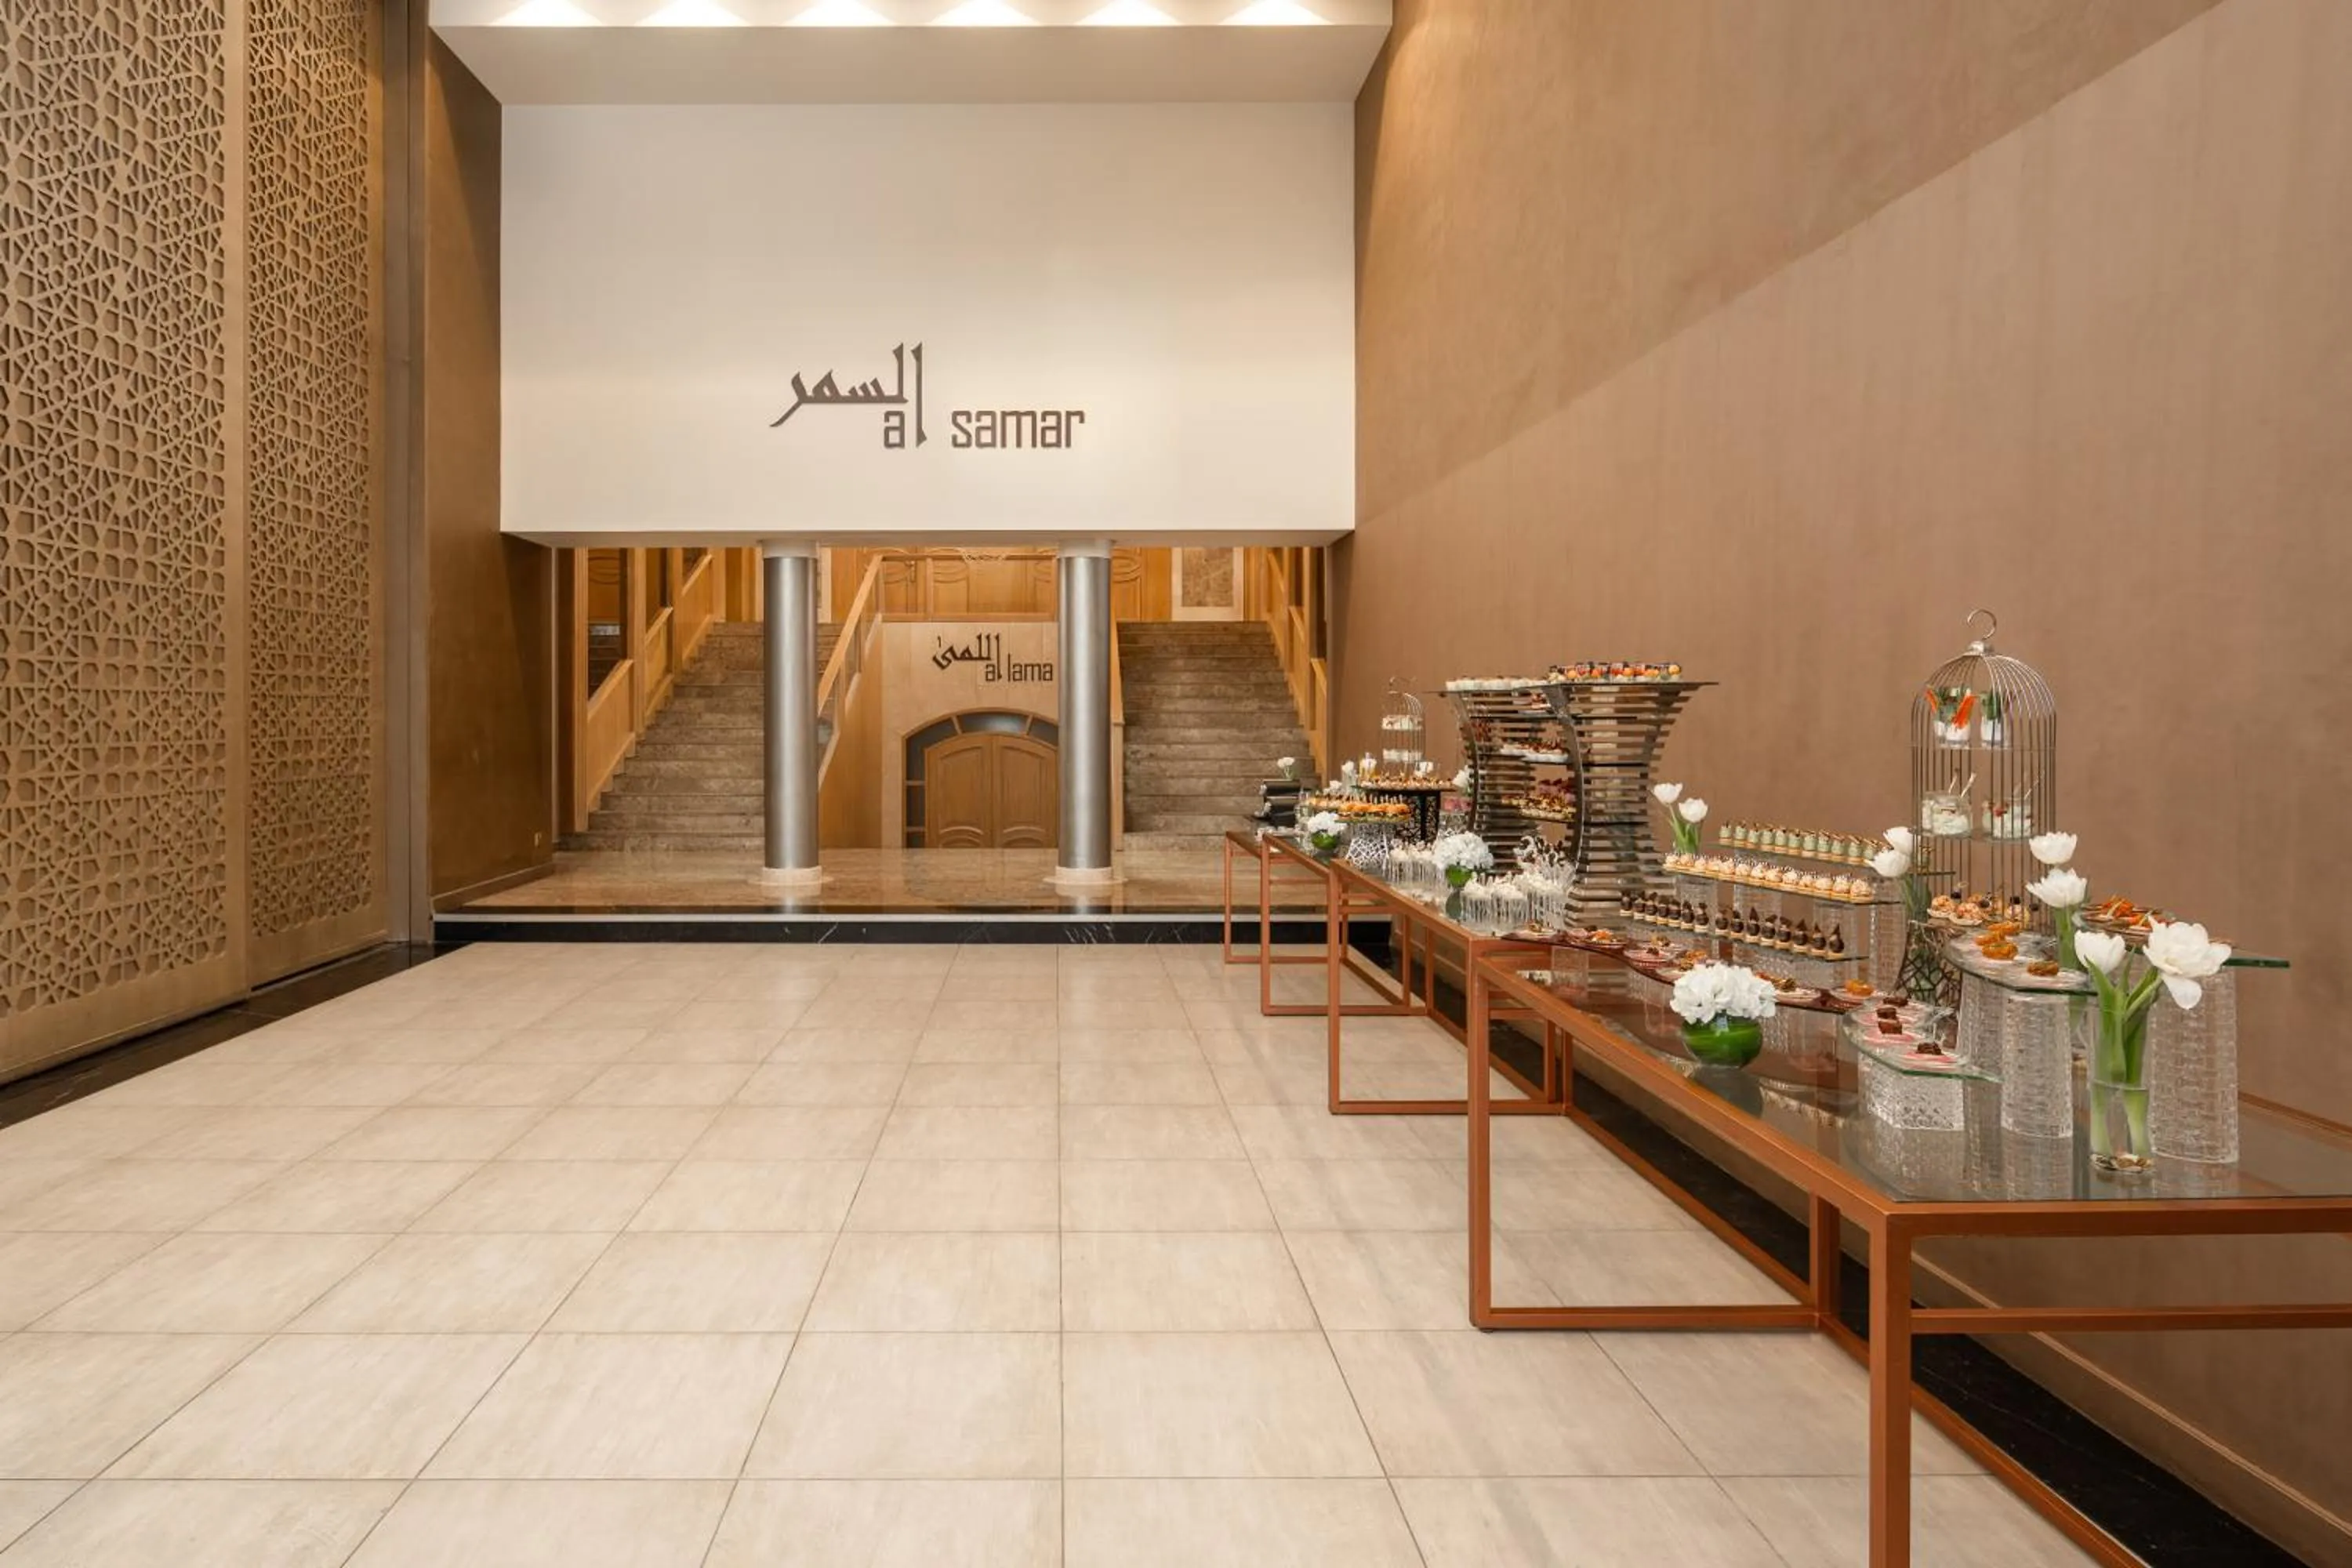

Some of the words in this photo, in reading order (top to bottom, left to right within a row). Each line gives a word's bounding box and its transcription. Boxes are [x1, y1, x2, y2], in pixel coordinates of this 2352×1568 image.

[769, 342, 927, 448] السمر
[951, 410, 1085, 448] samar
[1008, 654, 1053, 681] lama
